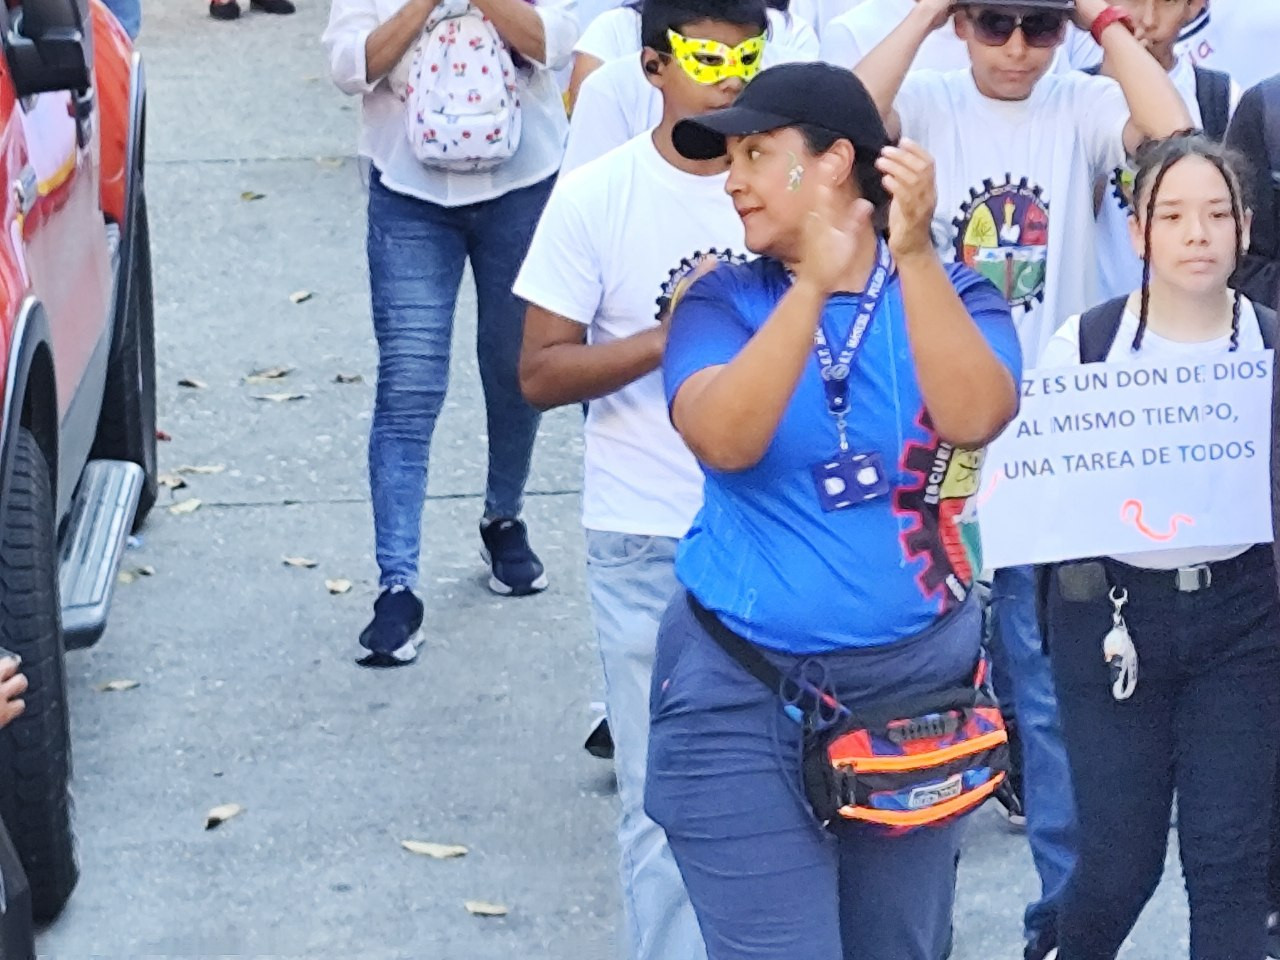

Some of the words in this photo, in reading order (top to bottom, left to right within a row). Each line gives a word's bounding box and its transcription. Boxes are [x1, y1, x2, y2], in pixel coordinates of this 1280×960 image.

[1043, 375, 1067, 395] ES
[1075, 372, 1108, 391] UN
[1117, 367, 1168, 388] DON
[1176, 364, 1205, 384] DE
[1213, 360, 1268, 381] DIOS
[1016, 419, 1043, 438] AL
[1052, 409, 1136, 434] MISMO
[1004, 458, 1055, 480] UNA
[1062, 449, 1135, 473] TAREA
[1142, 446, 1171, 466] DE
[1177, 440, 1256, 463] TODOS
